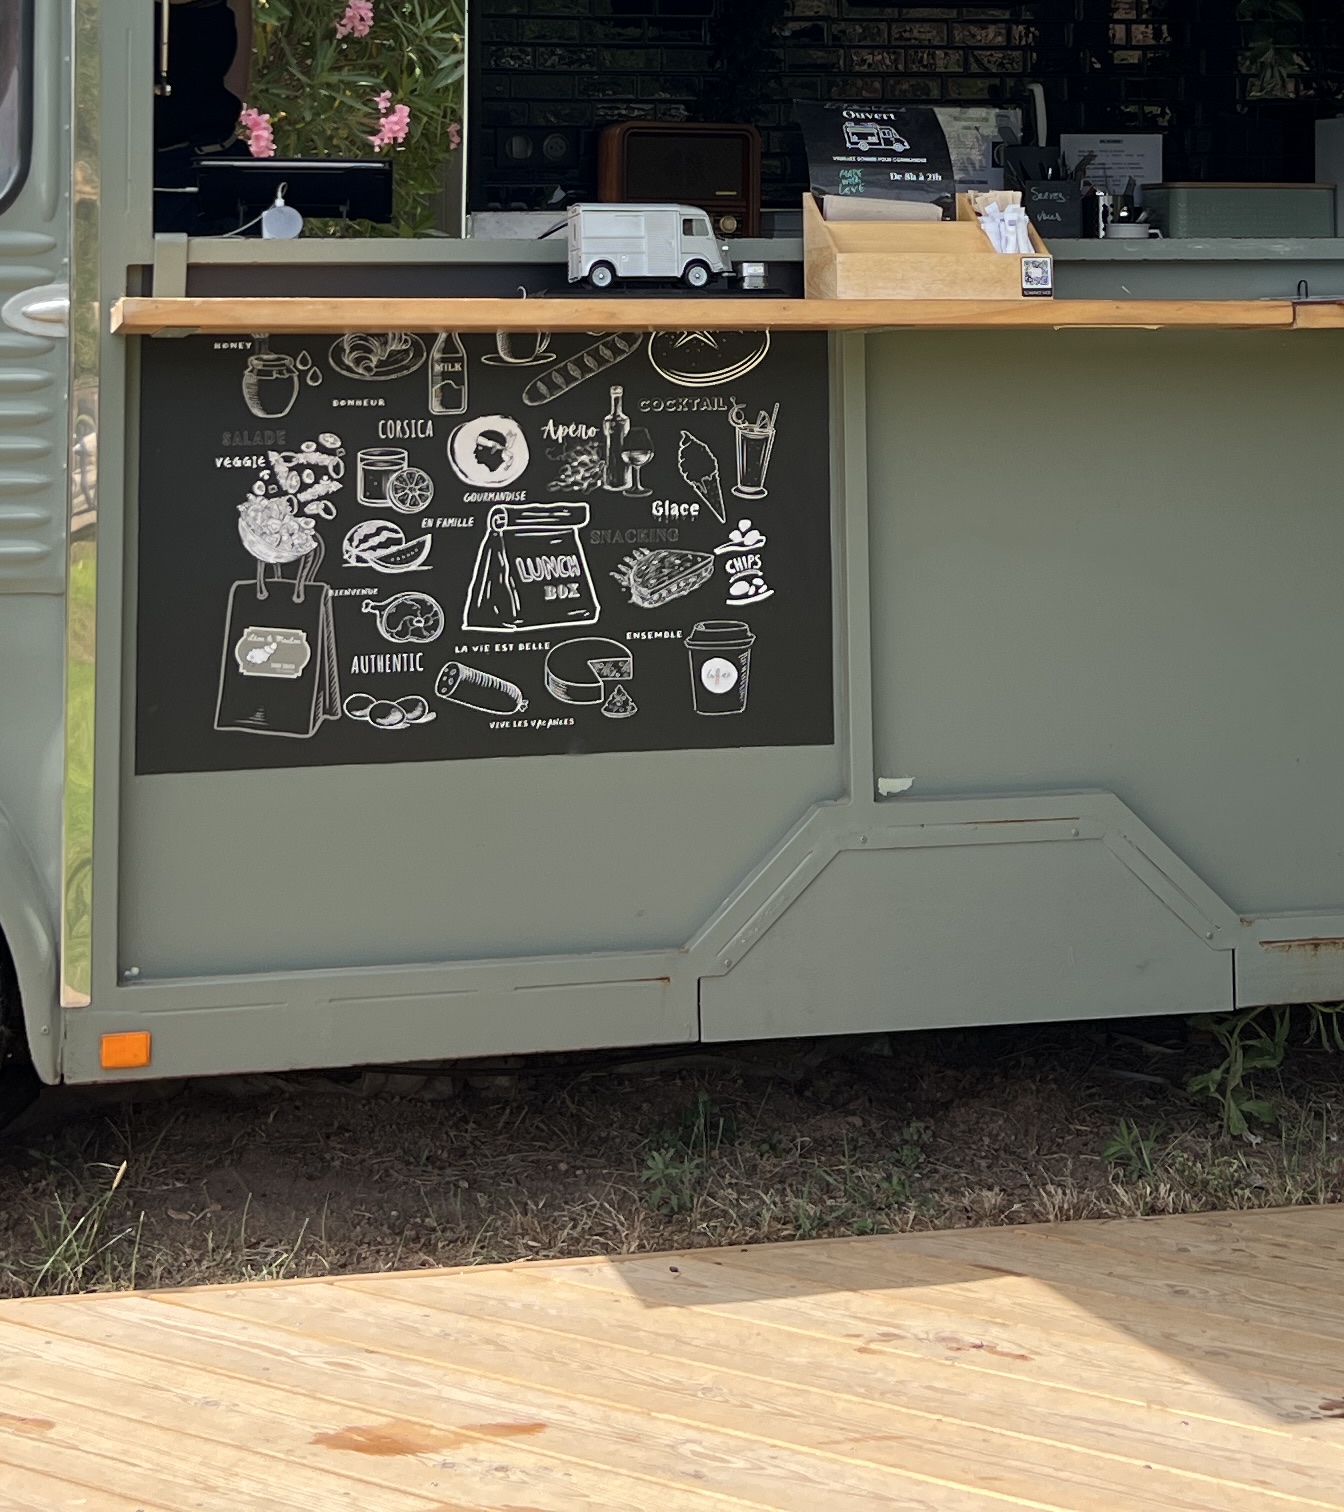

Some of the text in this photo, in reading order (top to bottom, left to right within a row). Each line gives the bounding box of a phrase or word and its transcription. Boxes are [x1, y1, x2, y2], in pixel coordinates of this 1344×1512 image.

[841, 109, 897, 121] Ouvert
[213, 341, 253, 351] HONEY
[435, 361, 463, 373] MILK
[638, 397, 728, 413] COCKTAIL
[378, 419, 434, 440] CORSICA
[541, 418, 601, 444] Apéro
[222, 429, 287, 448] SALADE
[463, 490, 527, 505] GOURMANDISE
[651, 499, 700, 518] Glace
[420, 516, 475, 530] EN FAMILLE
[589, 527, 680, 544] SNACKING
[515, 554, 581, 584] LUNCH
[725, 553, 763, 575] CHIPS
[543, 583, 581, 601] BOX
[625, 630, 684, 641] ENSEMBLE
[454, 645, 468, 654] LA
[495, 643, 515, 652] EST
[350, 652, 425, 676] AUTHENTIC
[489, 720, 511, 730] VIVE
[513, 720, 529, 728] LES
